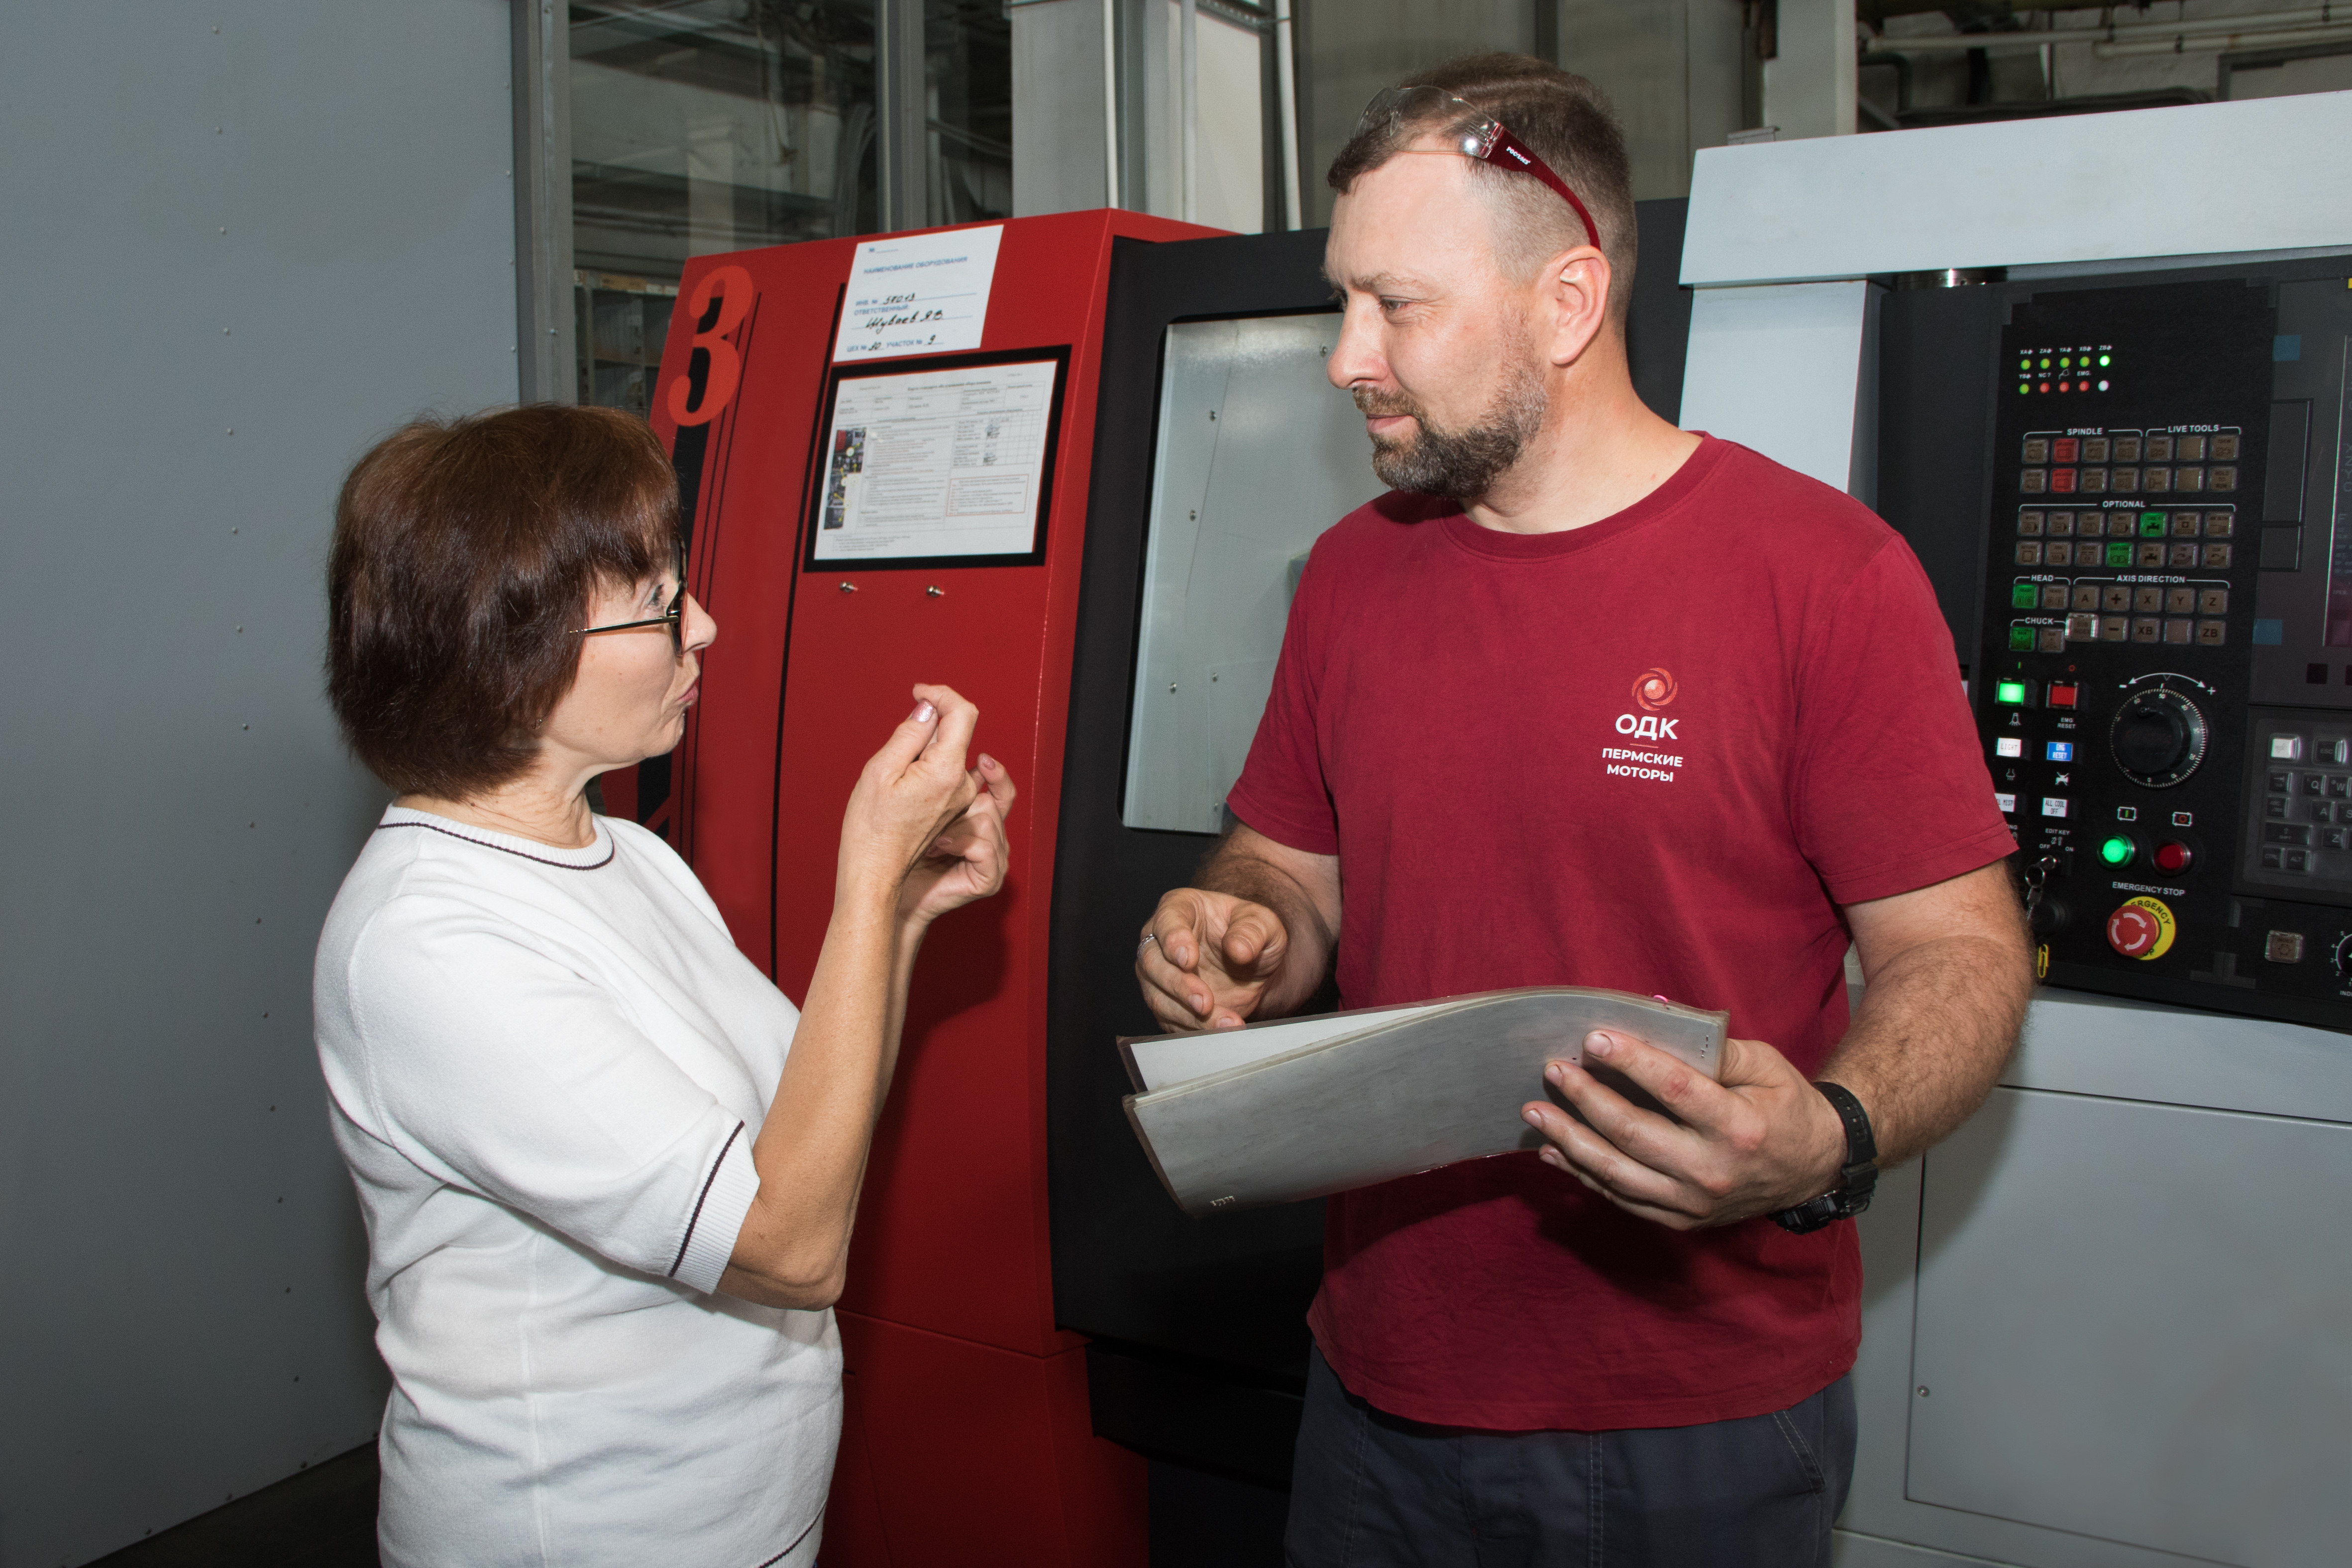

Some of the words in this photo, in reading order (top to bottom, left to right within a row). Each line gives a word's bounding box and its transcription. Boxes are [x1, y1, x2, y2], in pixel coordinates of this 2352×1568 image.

[863, 263, 914, 274] НАИМЕНОВАНИЕ
[915, 256, 967, 269] ОБОРУДОВАНИЯ
[667, 265, 753, 426] 3
[2081, 594, 2089, 602] A
[2143, 595, 2151, 604] X
[2177, 596, 2184, 605] Y
[2209, 597, 2217, 606] Z
[2138, 626, 2153, 635] XB
[2203, 628, 2218, 637] ZB
[1615, 714, 1679, 741] ОДК
[2001, 742, 2018, 751] LIGHT
[1602, 748, 1683, 767] ПЕРМСКИЕ
[1606, 764, 1674, 782] МОТОРЫ
[2311, 780, 2319, 790] Q
[2336, 782, 2346, 792] W
[2319, 807, 2327, 816] A
[2331, 834, 2340, 843] Z
[2112, 881, 2162, 894] EMERGENCY
[2163, 887, 2186, 896] STOP
